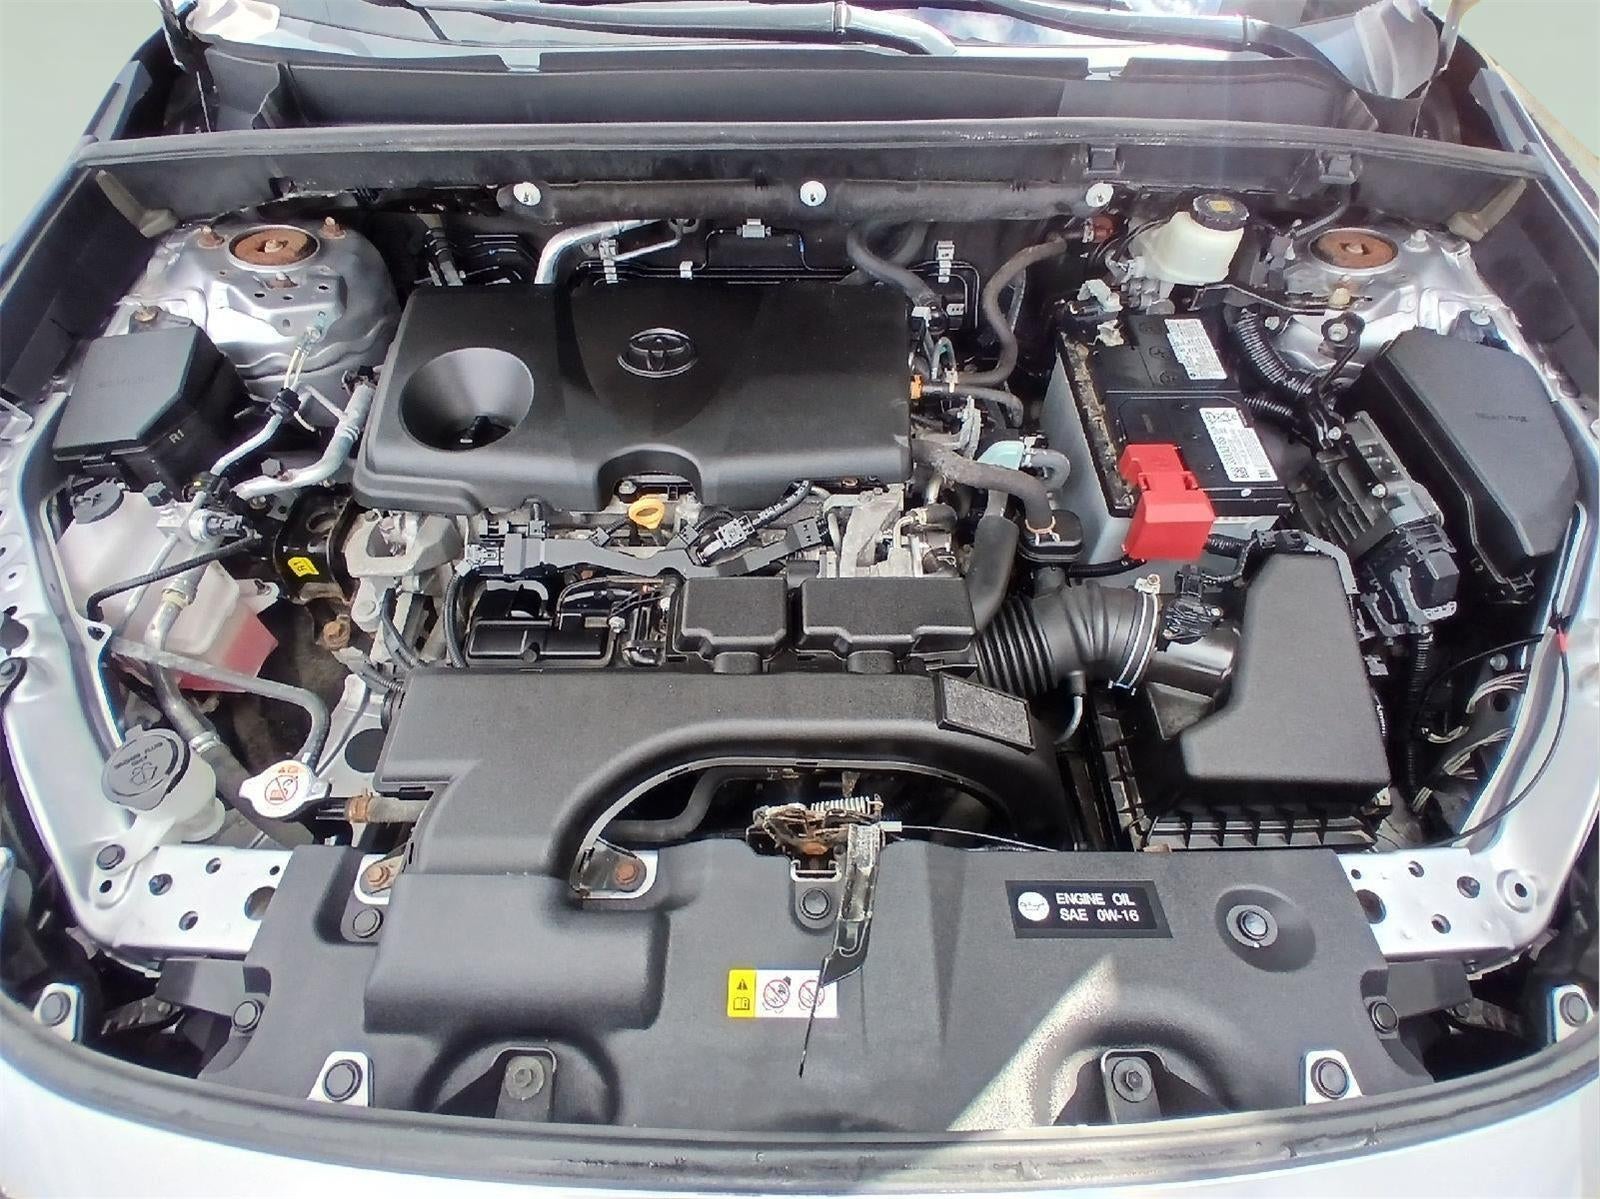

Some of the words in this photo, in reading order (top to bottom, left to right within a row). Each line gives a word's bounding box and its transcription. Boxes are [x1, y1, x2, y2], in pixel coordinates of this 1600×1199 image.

[169, 429, 184, 443] R1
[1055, 892, 1106, 906] ENGINE
[1112, 893, 1136, 906] OIL
[1059, 908, 1089, 921] SAE
[1097, 909, 1139, 921] 0W-16
